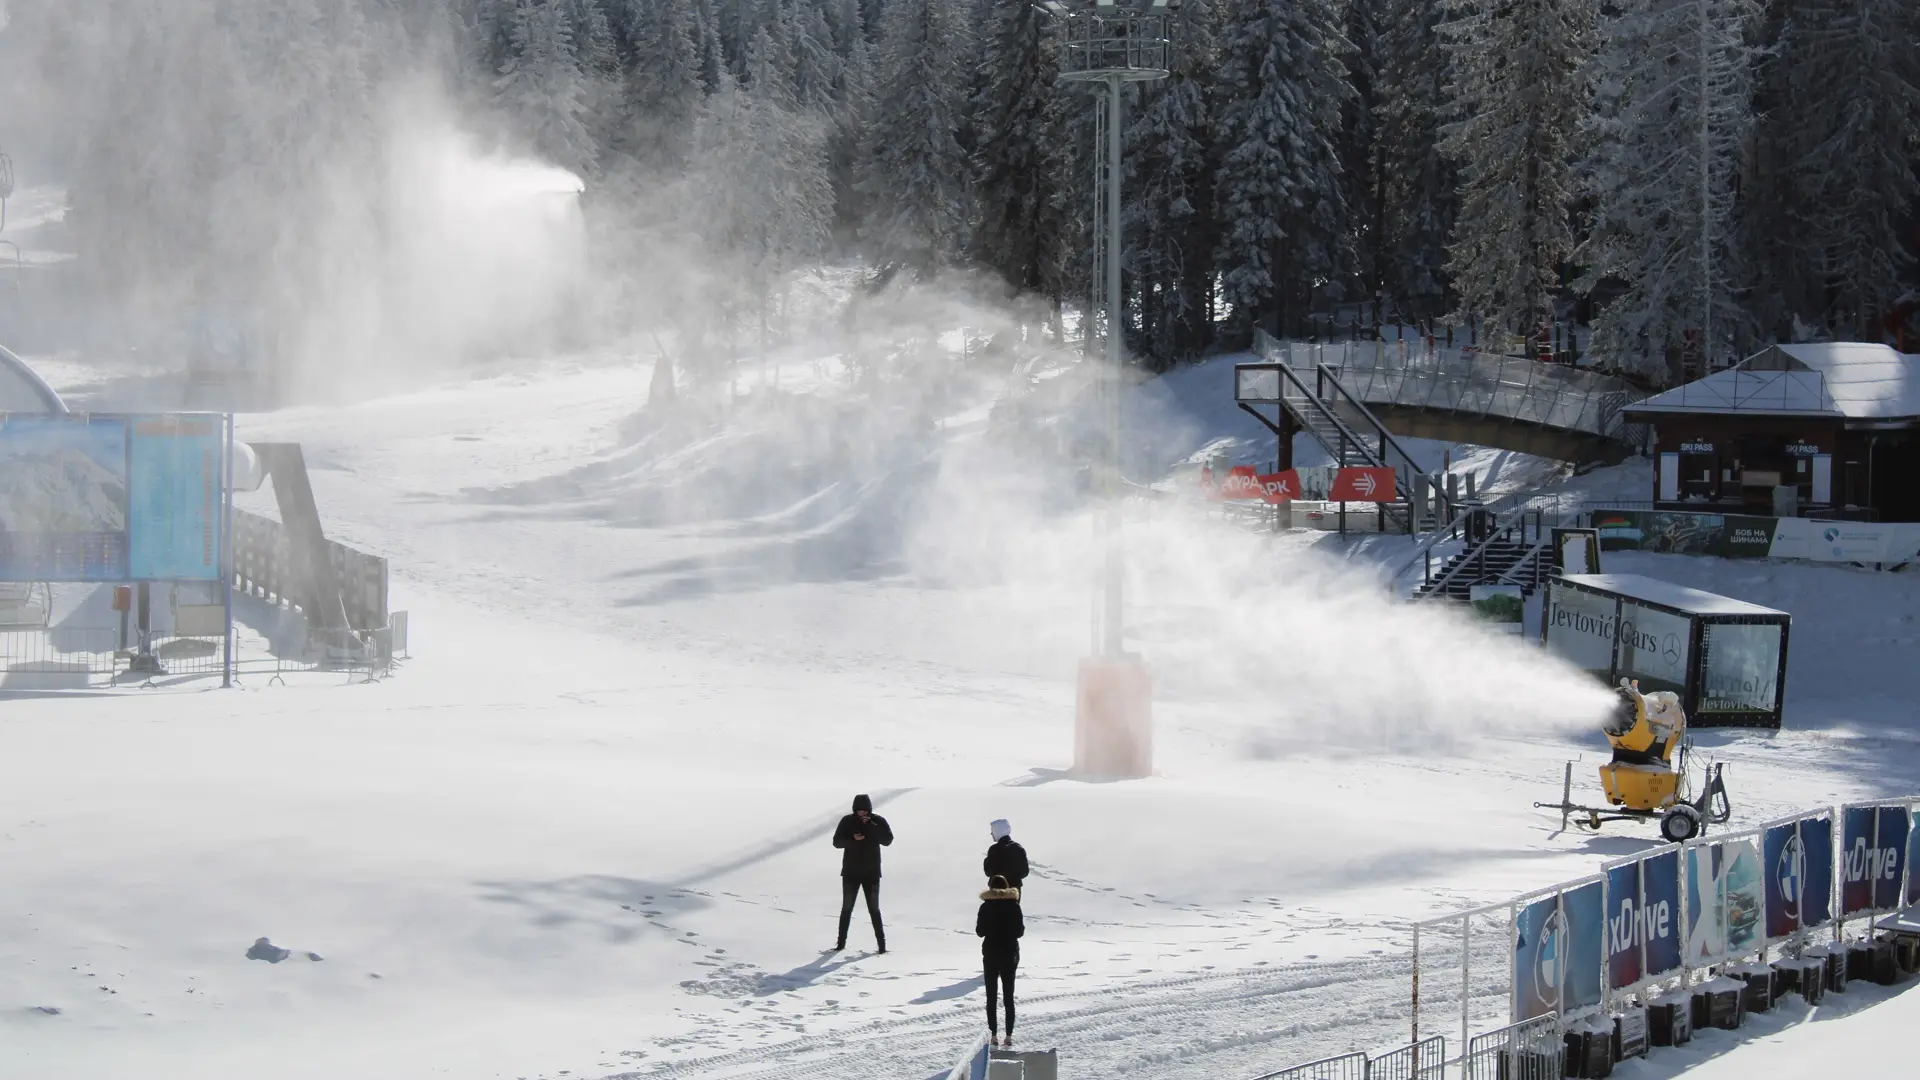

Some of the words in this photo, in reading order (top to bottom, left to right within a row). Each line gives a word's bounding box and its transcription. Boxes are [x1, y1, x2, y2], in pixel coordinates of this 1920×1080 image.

[1681, 443, 1693, 451] SKI
[1694, 443, 1714, 452] PASS
[1785, 444, 1798, 453] SKI
[1799, 444, 1819, 454] PASS
[1735, 528, 1752, 537] БОБ
[1753, 529, 1766, 537] НА
[1730, 535, 1769, 545] ШИНАМА
[1550, 602, 1612, 639] Jevtović
[1620, 620, 1657, 653] Cars
